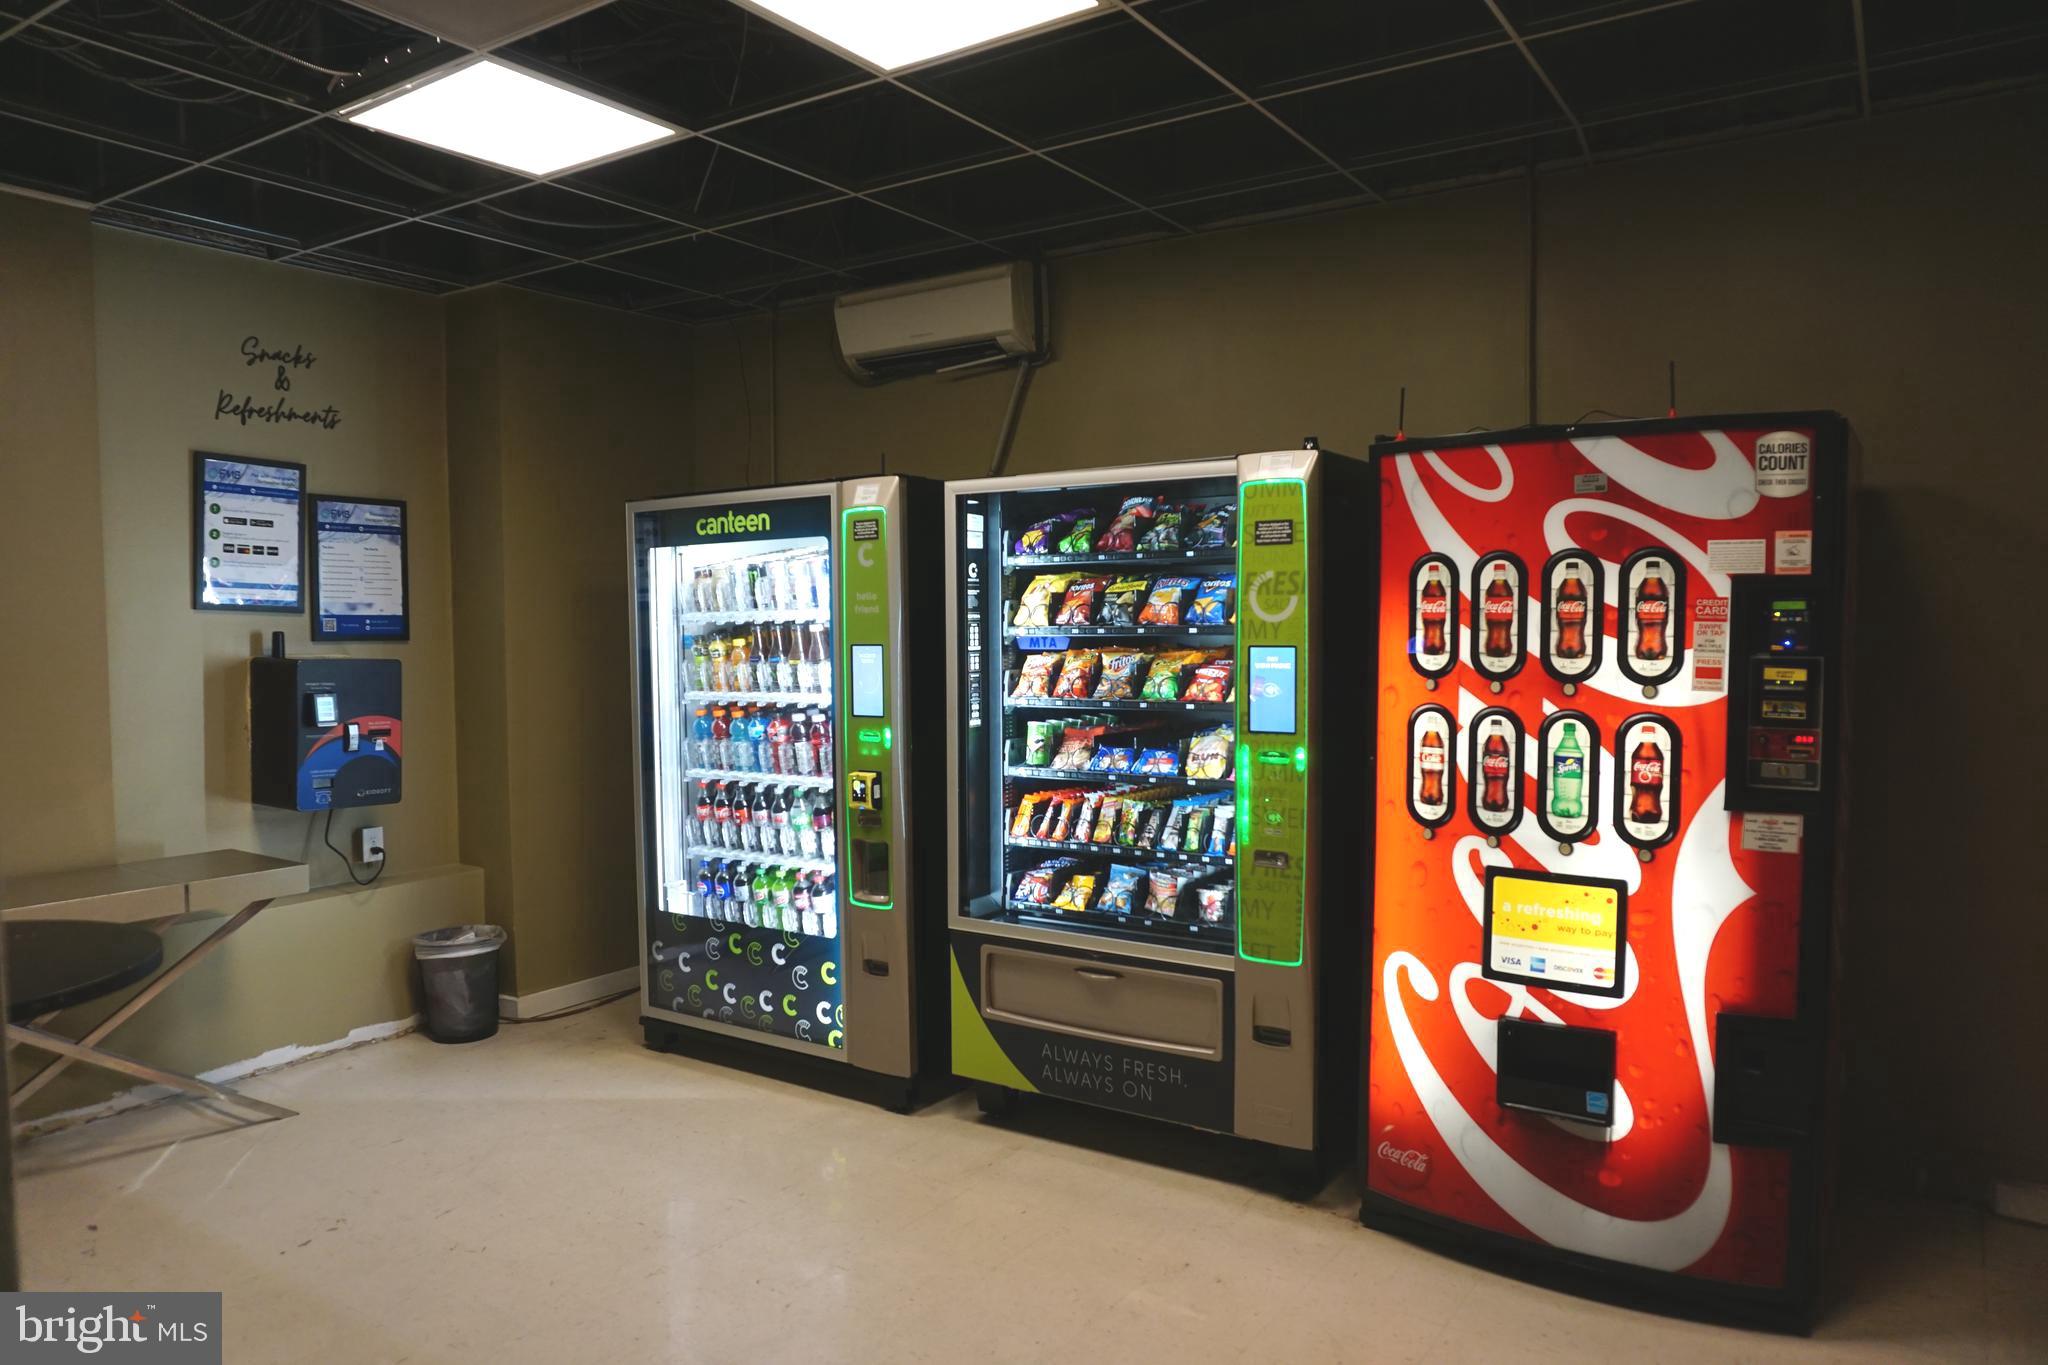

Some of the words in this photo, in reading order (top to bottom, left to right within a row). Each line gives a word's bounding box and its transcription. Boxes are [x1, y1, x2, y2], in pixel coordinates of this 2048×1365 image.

[241, 336, 317, 369] Snacks
[274, 365, 290, 391] &
[215, 389, 342, 429] Refreshments
[1758, 443, 1808, 454] CALORIES
[1758, 455, 1807, 471] COUNT
[695, 510, 770, 536] canteen
[1695, 606, 1728, 615] CARD
[1029, 637, 1057, 649] MTA
[1556, 763, 1580, 774] Sprite
[1502, 902, 1512, 913] a
[1516, 903, 1604, 927] refreshing
[1557, 924, 1578, 935] way
[1580, 926, 1592, 935] to
[1594, 928, 1615, 939] pay
[1501, 956, 1522, 966] VISA
[1041, 1042, 1113, 1072] ALWAYS
[1123, 1058, 1188, 1088] FRESH.
[1041, 1064, 1114, 1093] ALWAYS
[1122, 1080, 1152, 1101] ON
[1377, 1141, 1429, 1172] Coca-Cola
